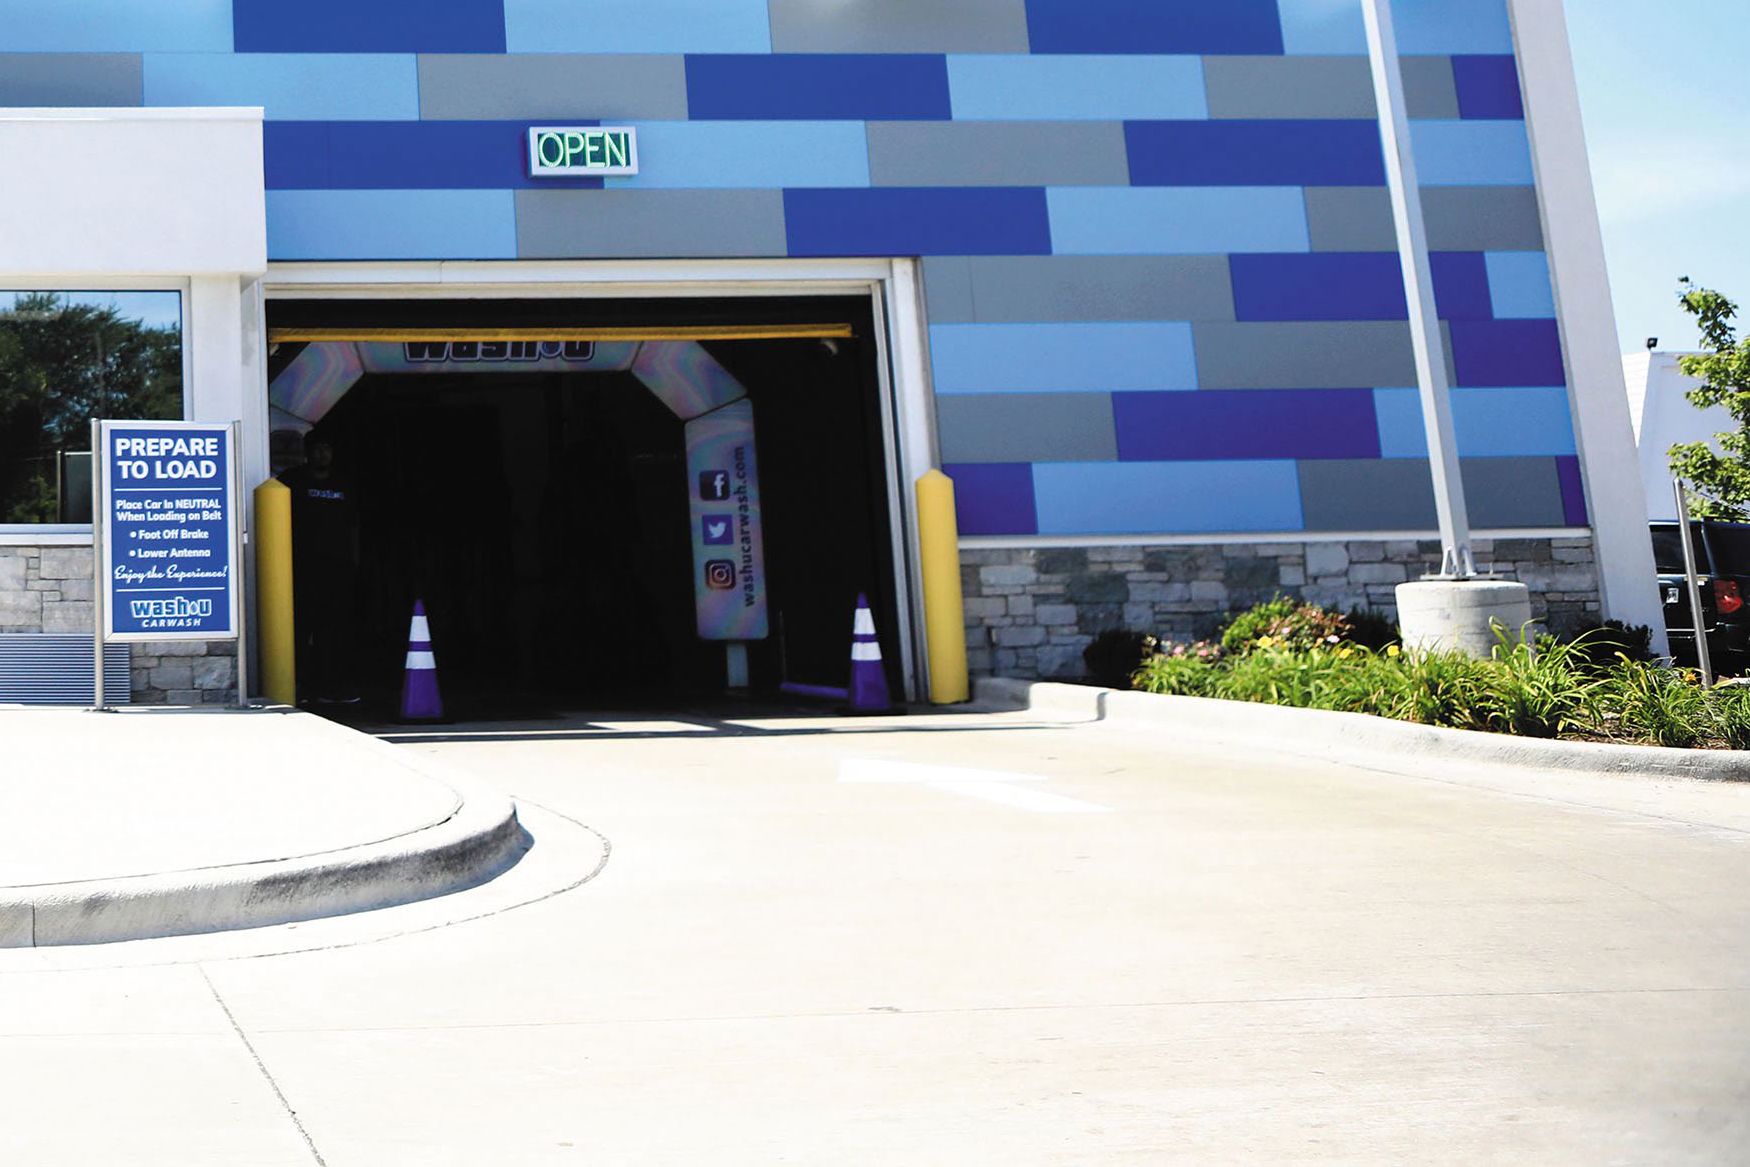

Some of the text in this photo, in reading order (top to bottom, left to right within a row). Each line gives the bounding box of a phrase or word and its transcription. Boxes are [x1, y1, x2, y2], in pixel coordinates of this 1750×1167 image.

[538, 132, 627, 168] OPEN
[116, 438, 218, 456] PREPARE
[117, 460, 216, 479] TO LOAD
[116, 500, 142, 509] Place
[145, 500, 162, 509] Car
[175, 499, 221, 509] NEUTRAL
[117, 510, 222, 523] When Loading on Belt
[138, 529, 209, 539] Foot Off Brake
[734, 447, 754, 607] washucarwash.com
[138, 548, 210, 558] Lower Antenna
[114, 565, 147, 584] Enjoy
[142, 619, 201, 627] CARWASH
